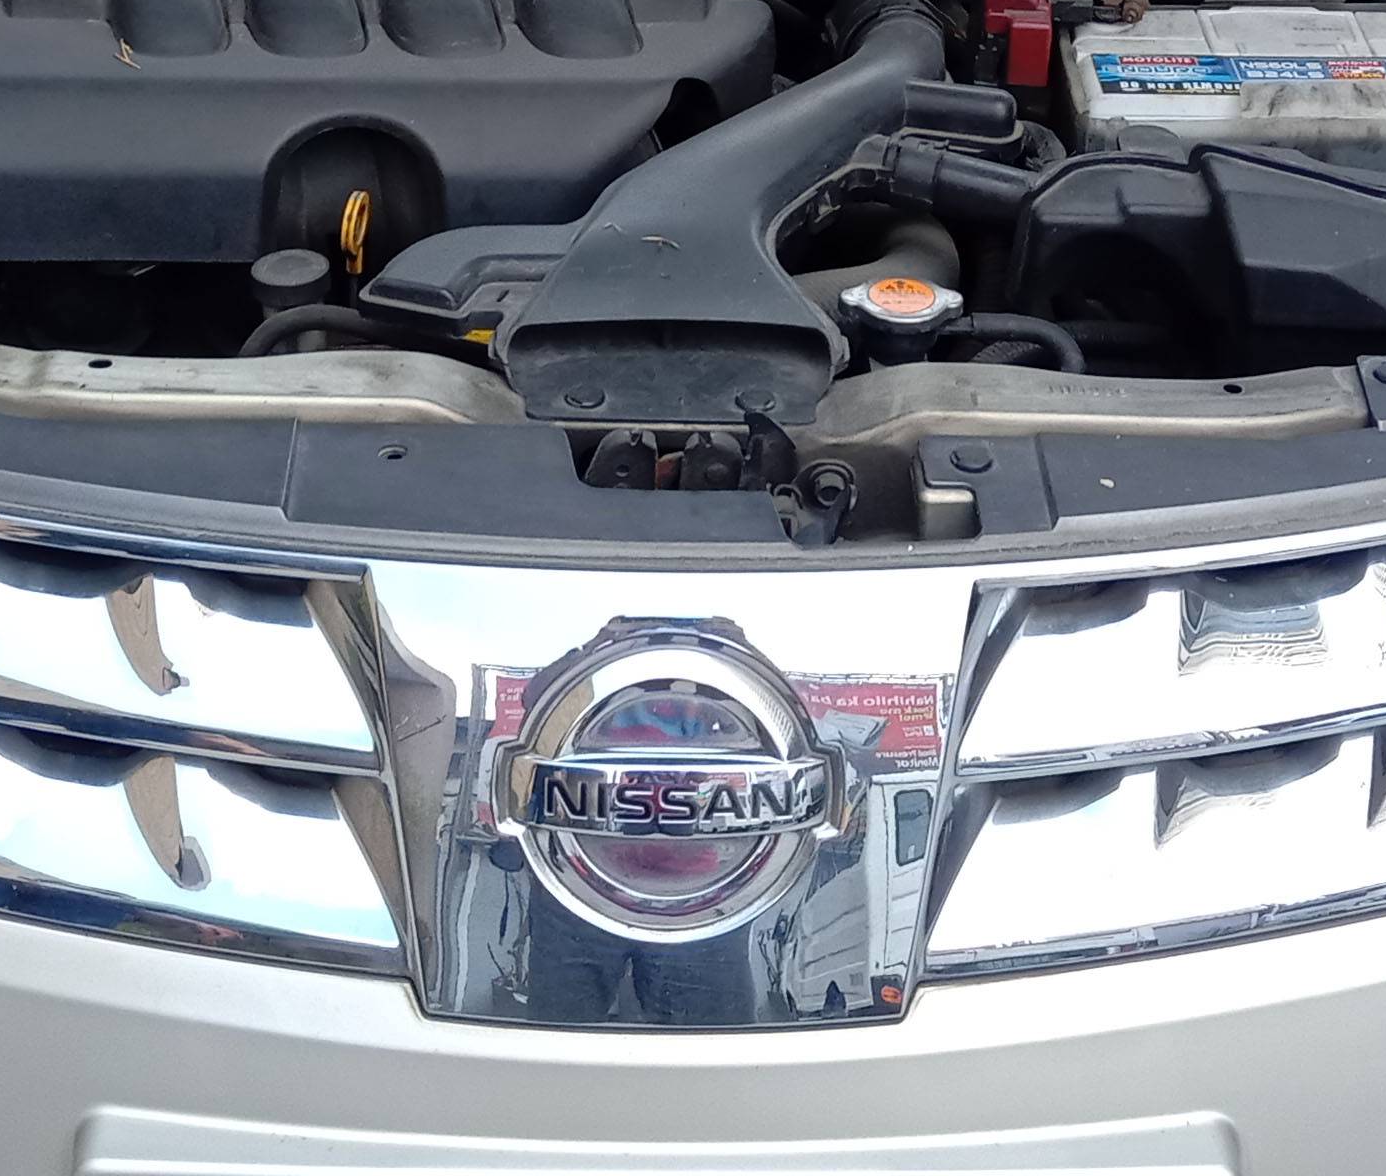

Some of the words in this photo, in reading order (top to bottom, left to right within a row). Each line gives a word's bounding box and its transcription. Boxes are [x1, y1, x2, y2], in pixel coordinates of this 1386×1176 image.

[1121, 56, 1192, 64] MOTOLITE
[1120, 80, 1140, 88] DO
[1146, 81, 1175, 90] NOT
[543, 777, 795, 824] NISSAN
